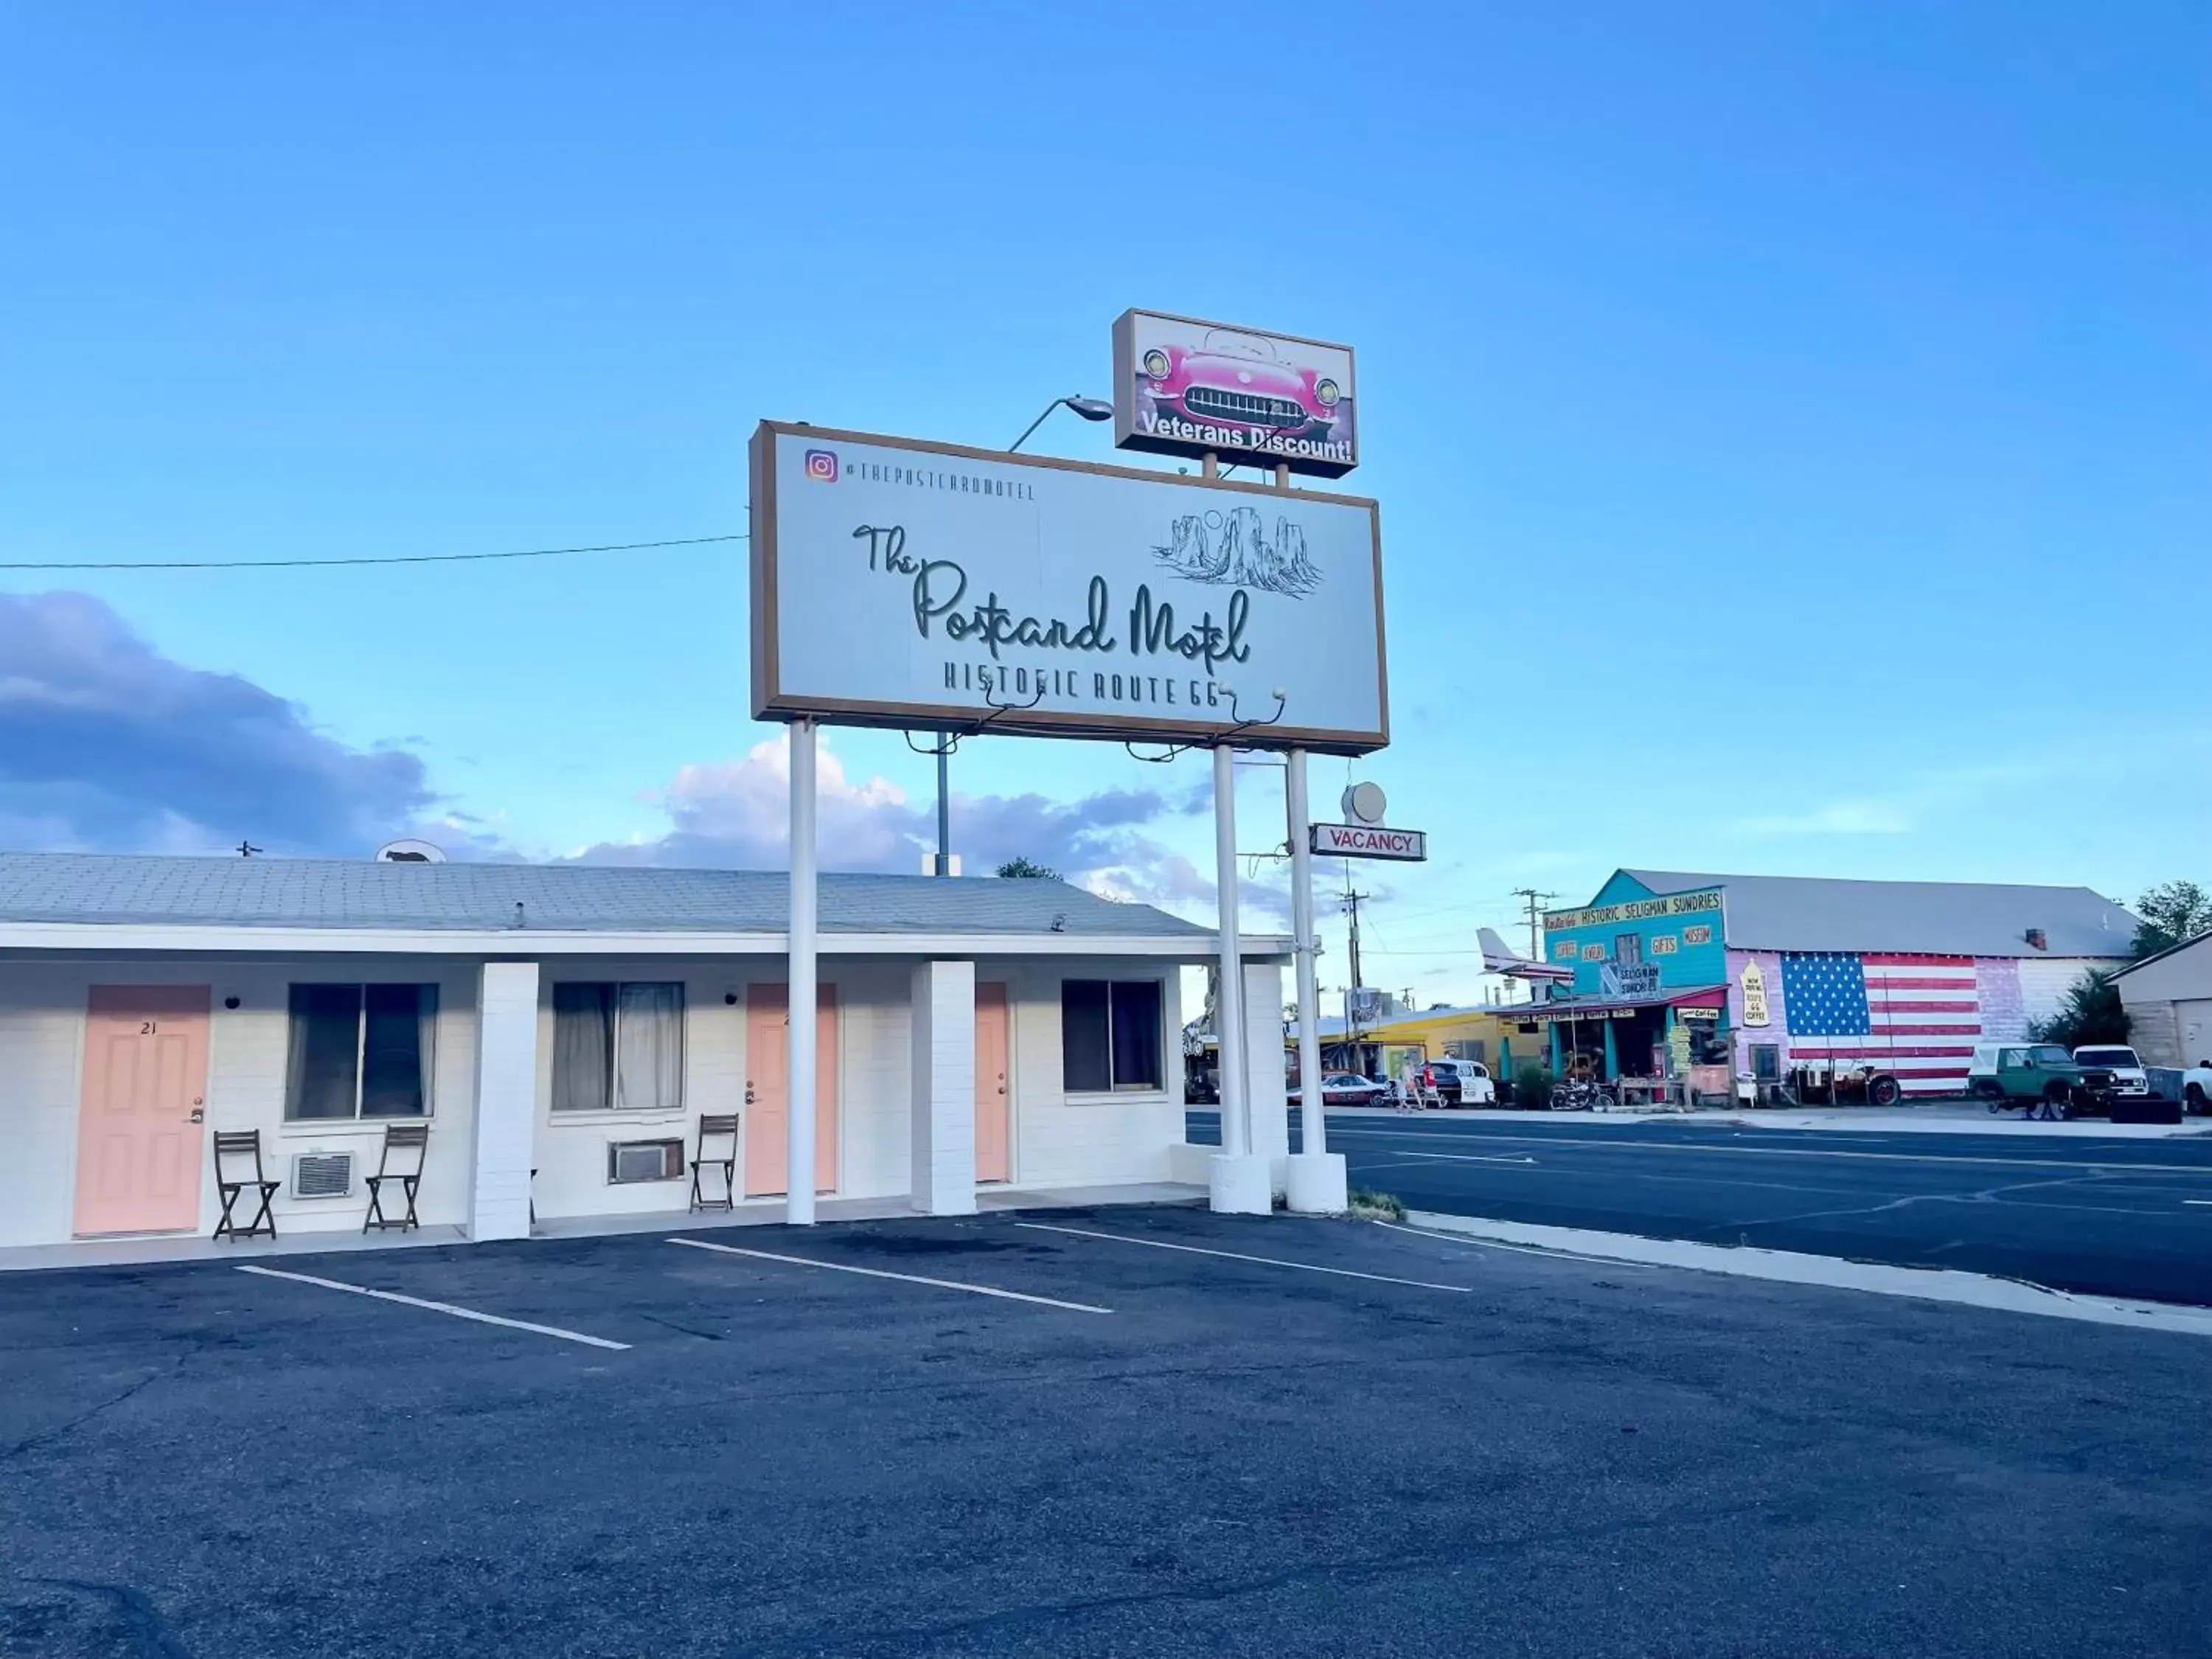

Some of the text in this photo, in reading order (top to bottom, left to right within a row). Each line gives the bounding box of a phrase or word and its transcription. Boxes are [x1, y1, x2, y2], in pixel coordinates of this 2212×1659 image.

[1142, 411, 1352, 460] Veterans Discount!
[852, 524, 919, 574] The
[912, 558, 1251, 676] Postcard Motel
[944, 661, 1219, 706] HISTORIC ROUTE 66
[1330, 829, 1413, 852] VACANCY
[1582, 907, 1620, 925] HISTORIC
[1624, 899, 1667, 919] SELIGMAN
[1673, 893, 1719, 913] SUNDRIES
[1652, 937, 1675, 953] GIFTS
[1621, 967, 1658, 980] SELIGMAN
[141, 1021, 156, 1034] 21
[1745, 1011, 1765, 1020] COFFEE
